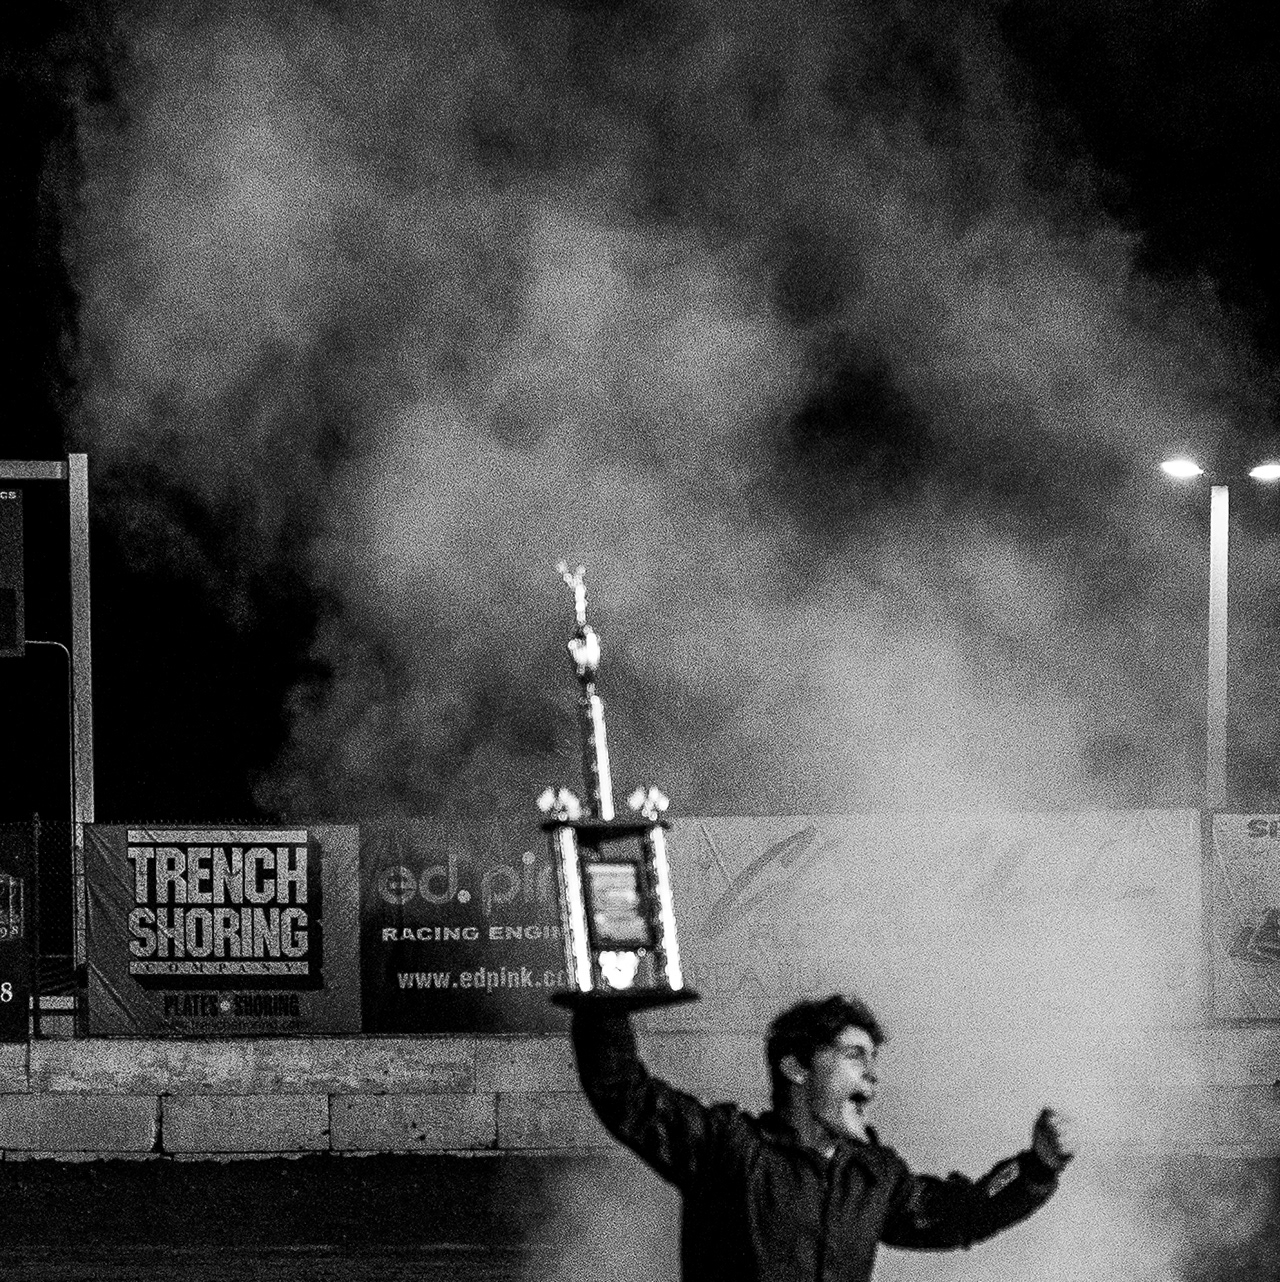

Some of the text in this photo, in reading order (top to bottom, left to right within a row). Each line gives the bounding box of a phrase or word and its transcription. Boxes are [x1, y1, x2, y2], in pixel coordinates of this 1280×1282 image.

[128, 847, 308, 903] TRENCH
[128, 907, 309, 959] SHORING
[381, 926, 480, 942] RACING
[397, 966, 568, 993] www.edpink.co
[164, 995, 218, 1017] PLATES
